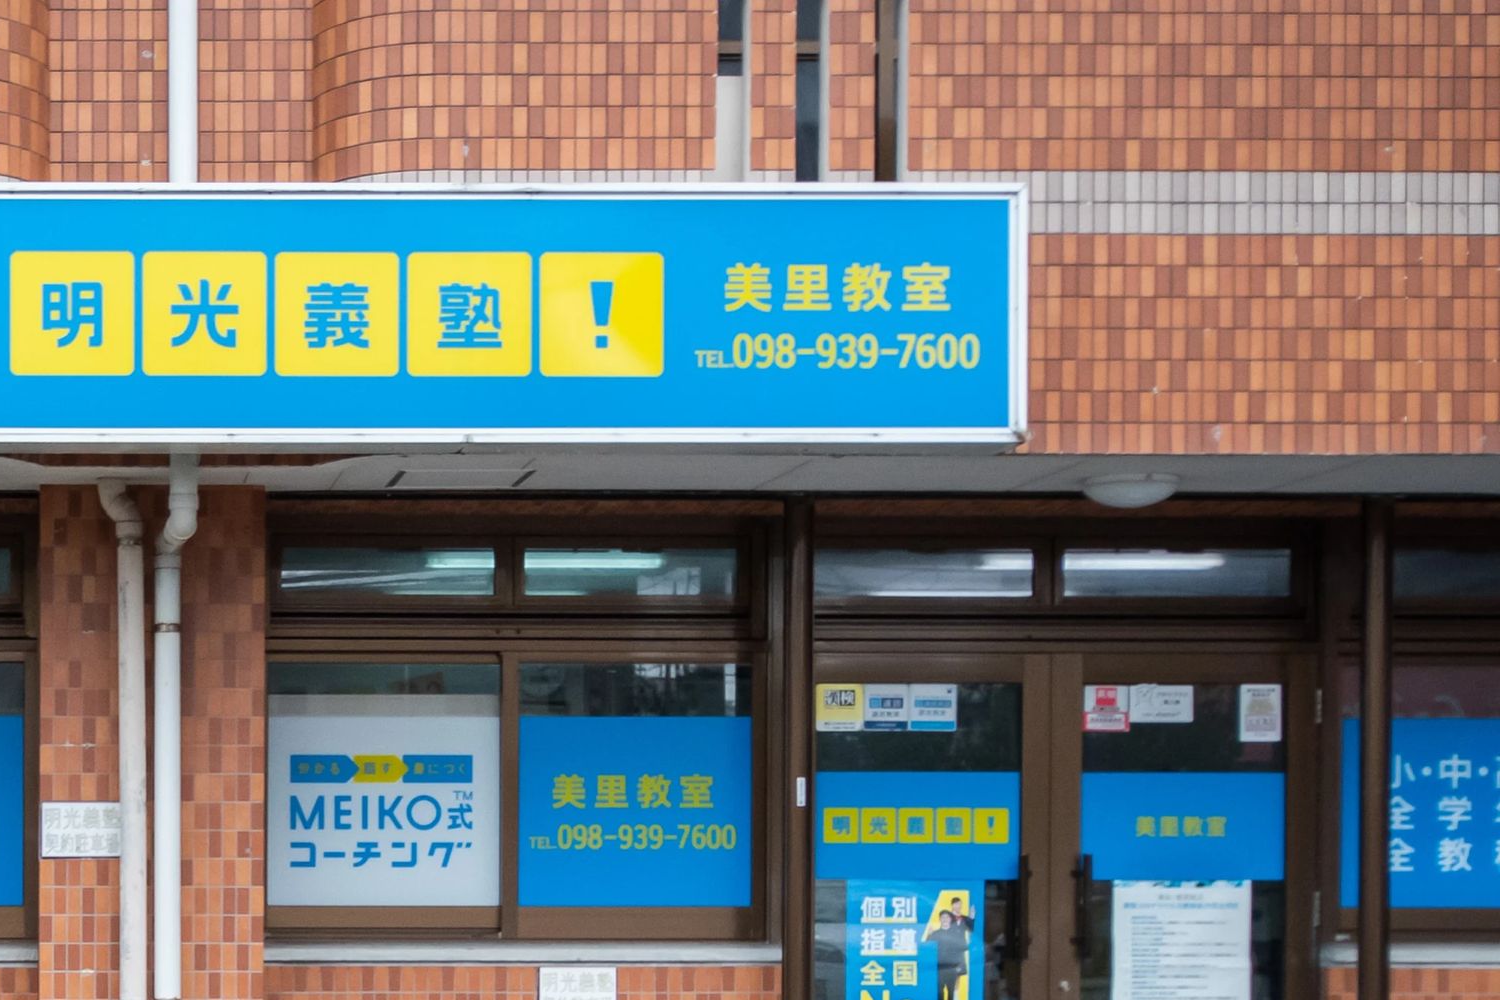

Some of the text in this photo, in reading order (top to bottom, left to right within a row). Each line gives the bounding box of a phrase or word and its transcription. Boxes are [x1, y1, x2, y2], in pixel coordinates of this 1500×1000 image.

[722, 262, 953, 313] 美里教室
[552, 774, 714, 808] 美里教室
[1389, 796, 1500, 830] 全学
[290, 842, 473, 868] コーチング
[1389, 837, 1500, 872] 全教
[860, 896, 918, 919] 個別
[860, 928, 918, 952] 指導
[860, 960, 918, 986] 全国
